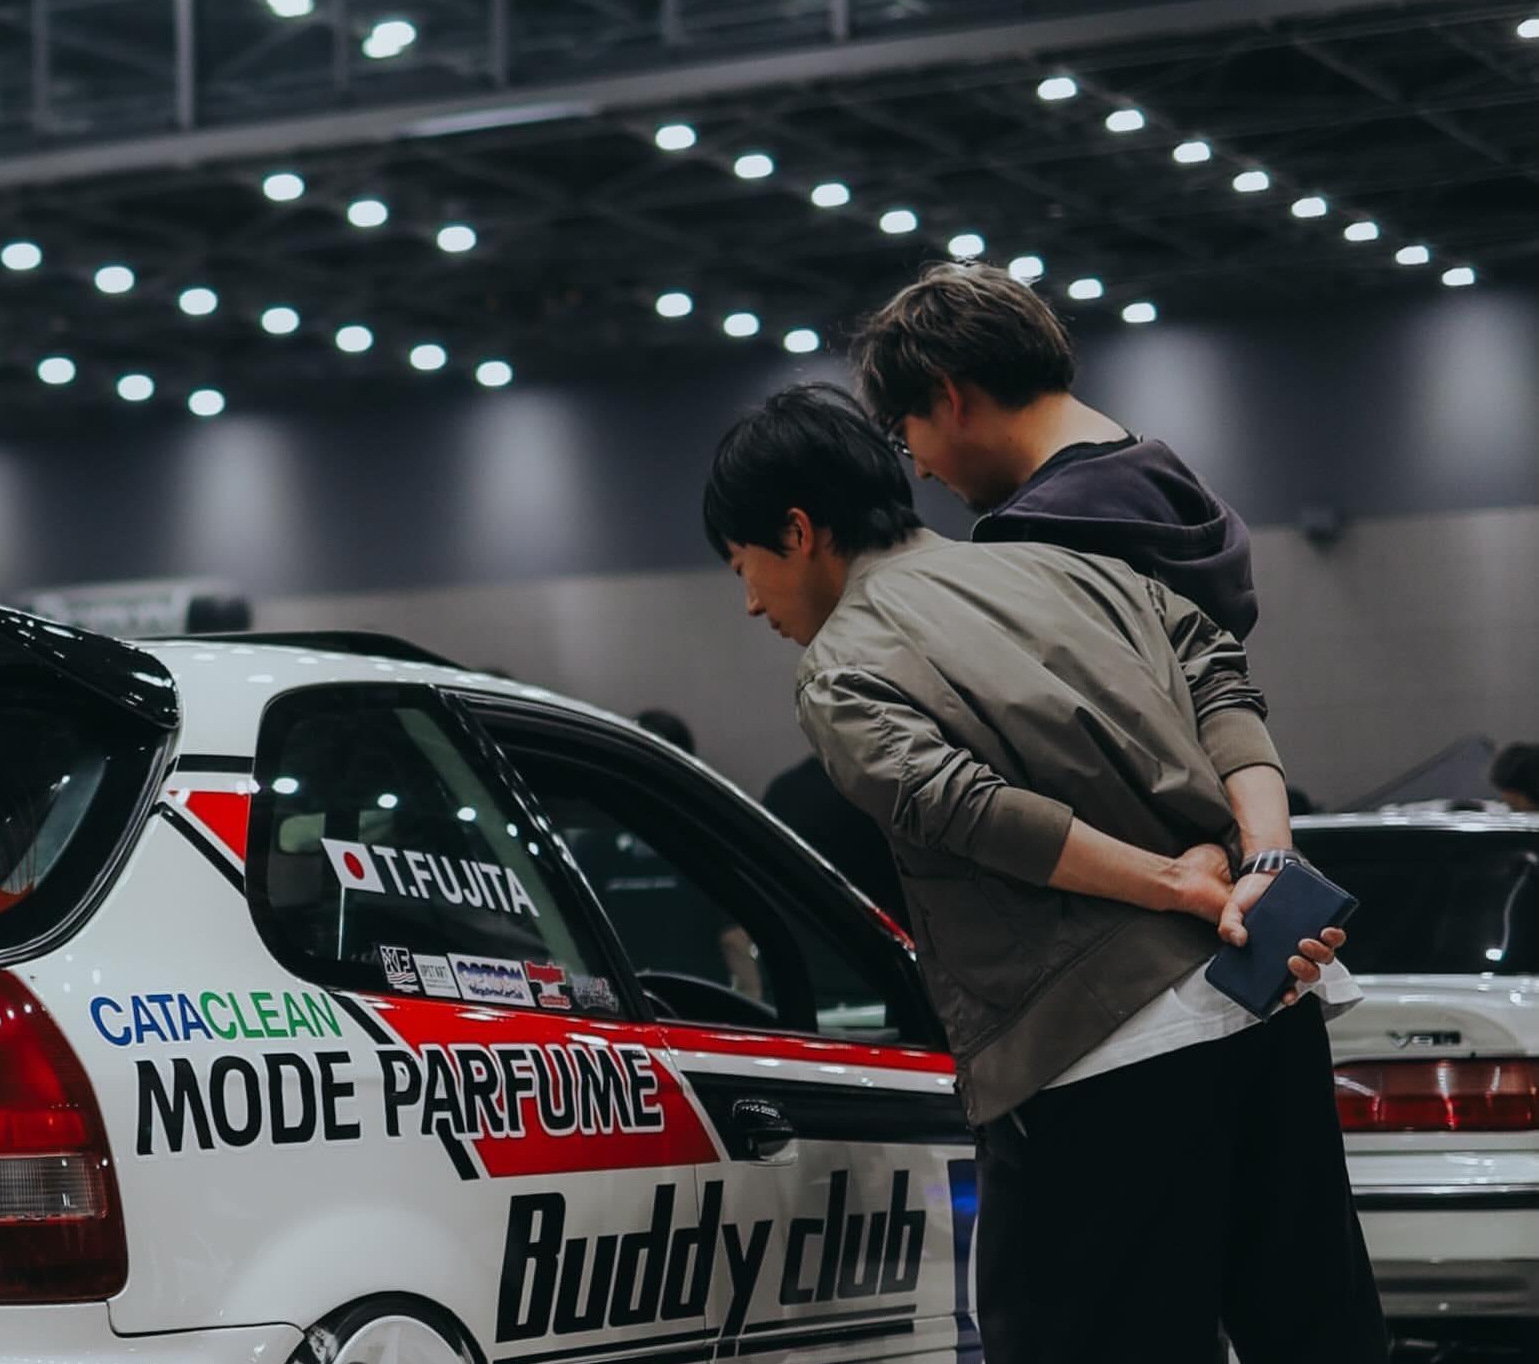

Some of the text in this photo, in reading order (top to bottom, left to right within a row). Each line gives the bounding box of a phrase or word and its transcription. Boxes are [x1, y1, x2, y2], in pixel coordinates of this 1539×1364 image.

[371, 845, 539, 917] T.FUJITA
[90, 991, 343, 1046] CATACLEAN
[136, 1046, 665, 1155] MODE PARFUME
[496, 1170, 927, 1357] Buddy club
